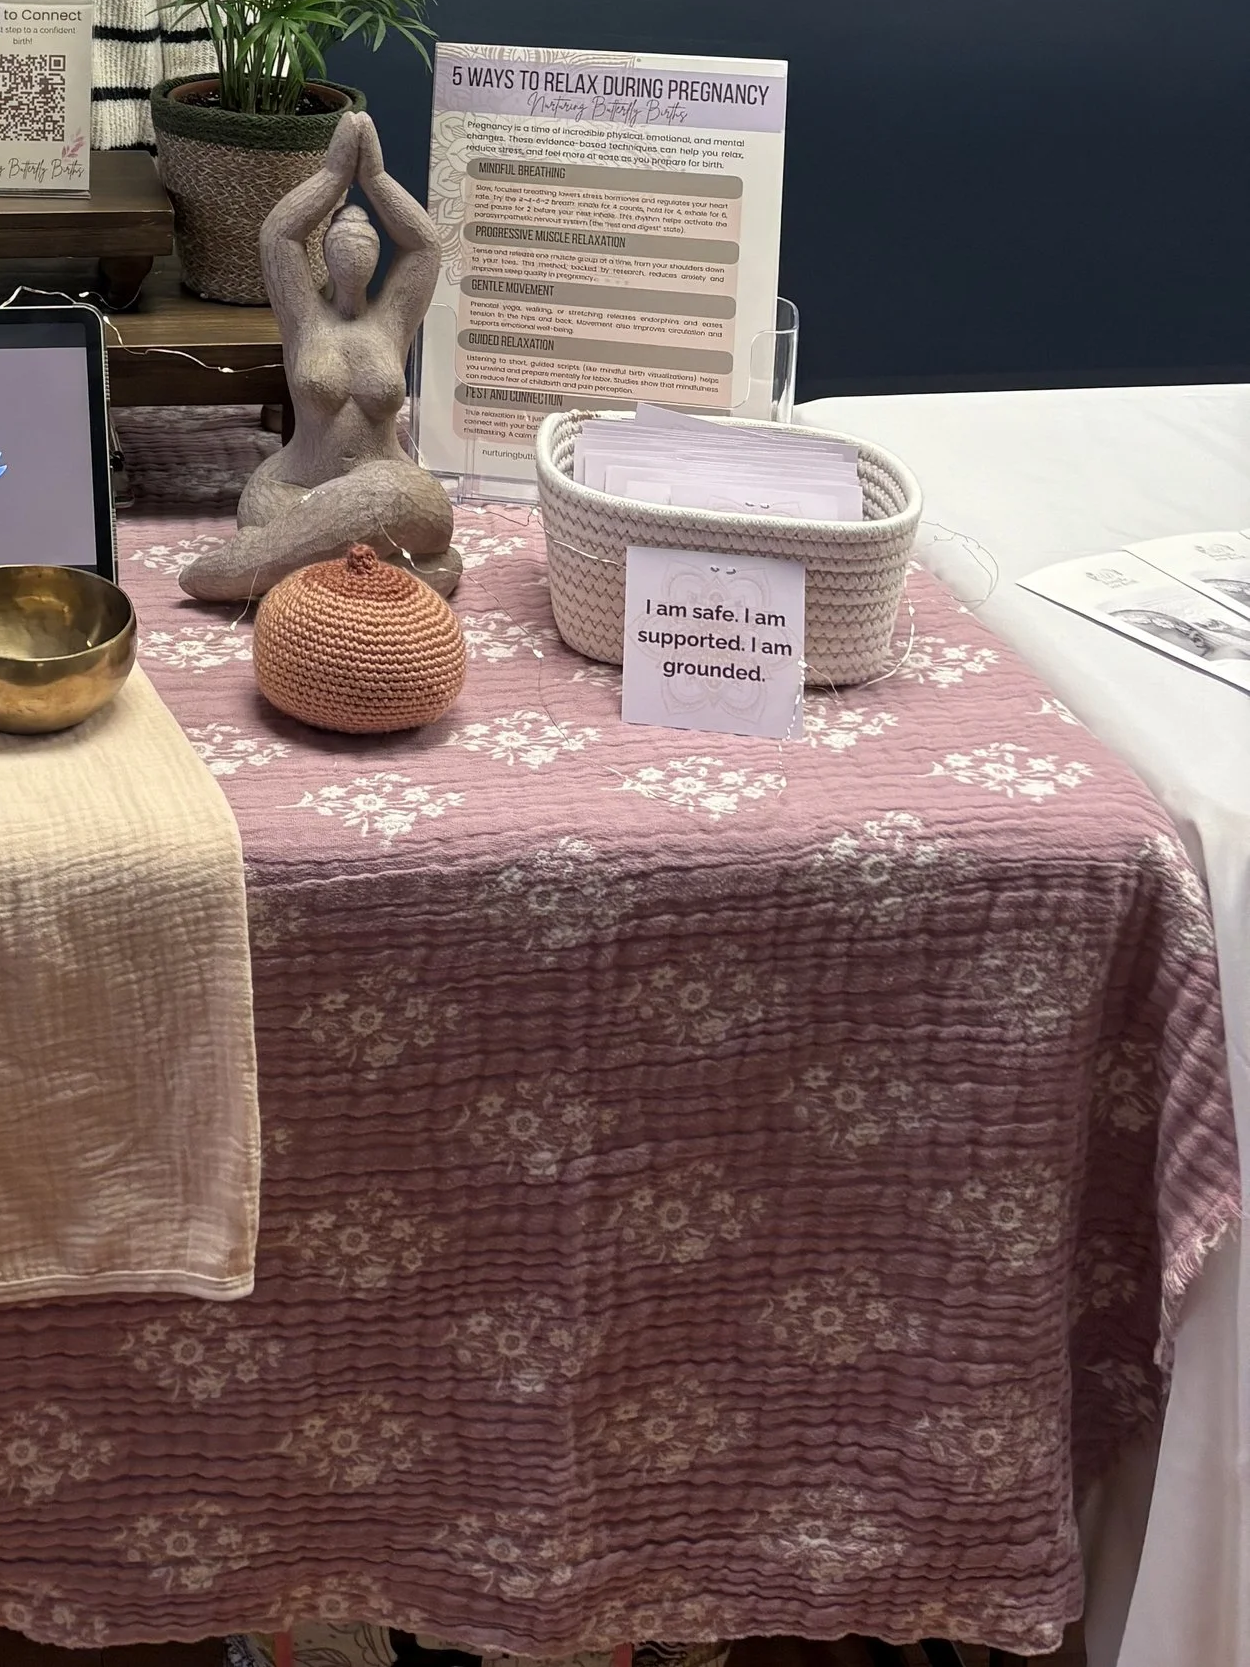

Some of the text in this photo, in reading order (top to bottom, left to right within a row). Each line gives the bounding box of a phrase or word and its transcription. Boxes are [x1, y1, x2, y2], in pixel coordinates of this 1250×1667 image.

[4, 9, 17, 20] to
[21, 9, 82, 21] Connect
[5, 26, 21, 34] step
[452, 67, 769, 106] 5 WAYS TO RELAX DURING PREGNANCY
[527, 91, 688, 126] Nurturing Butterfly Births
[8, 158, 48, 183] Butterfly
[51, 158, 84, 180] Births
[478, 163, 565, 178] MINDFUL BREATHING
[476, 226, 626, 248] PROGRESSIVE MUSCLE RELAXATION
[471, 280, 554, 296] GENTLE MOVEMENT
[468, 333, 554, 351] GUIDED RELAXATION
[646, 599, 785, 627] I am safe. I am
[638, 630, 792, 656] supported. I am
[663, 661, 765, 682] grounded.
